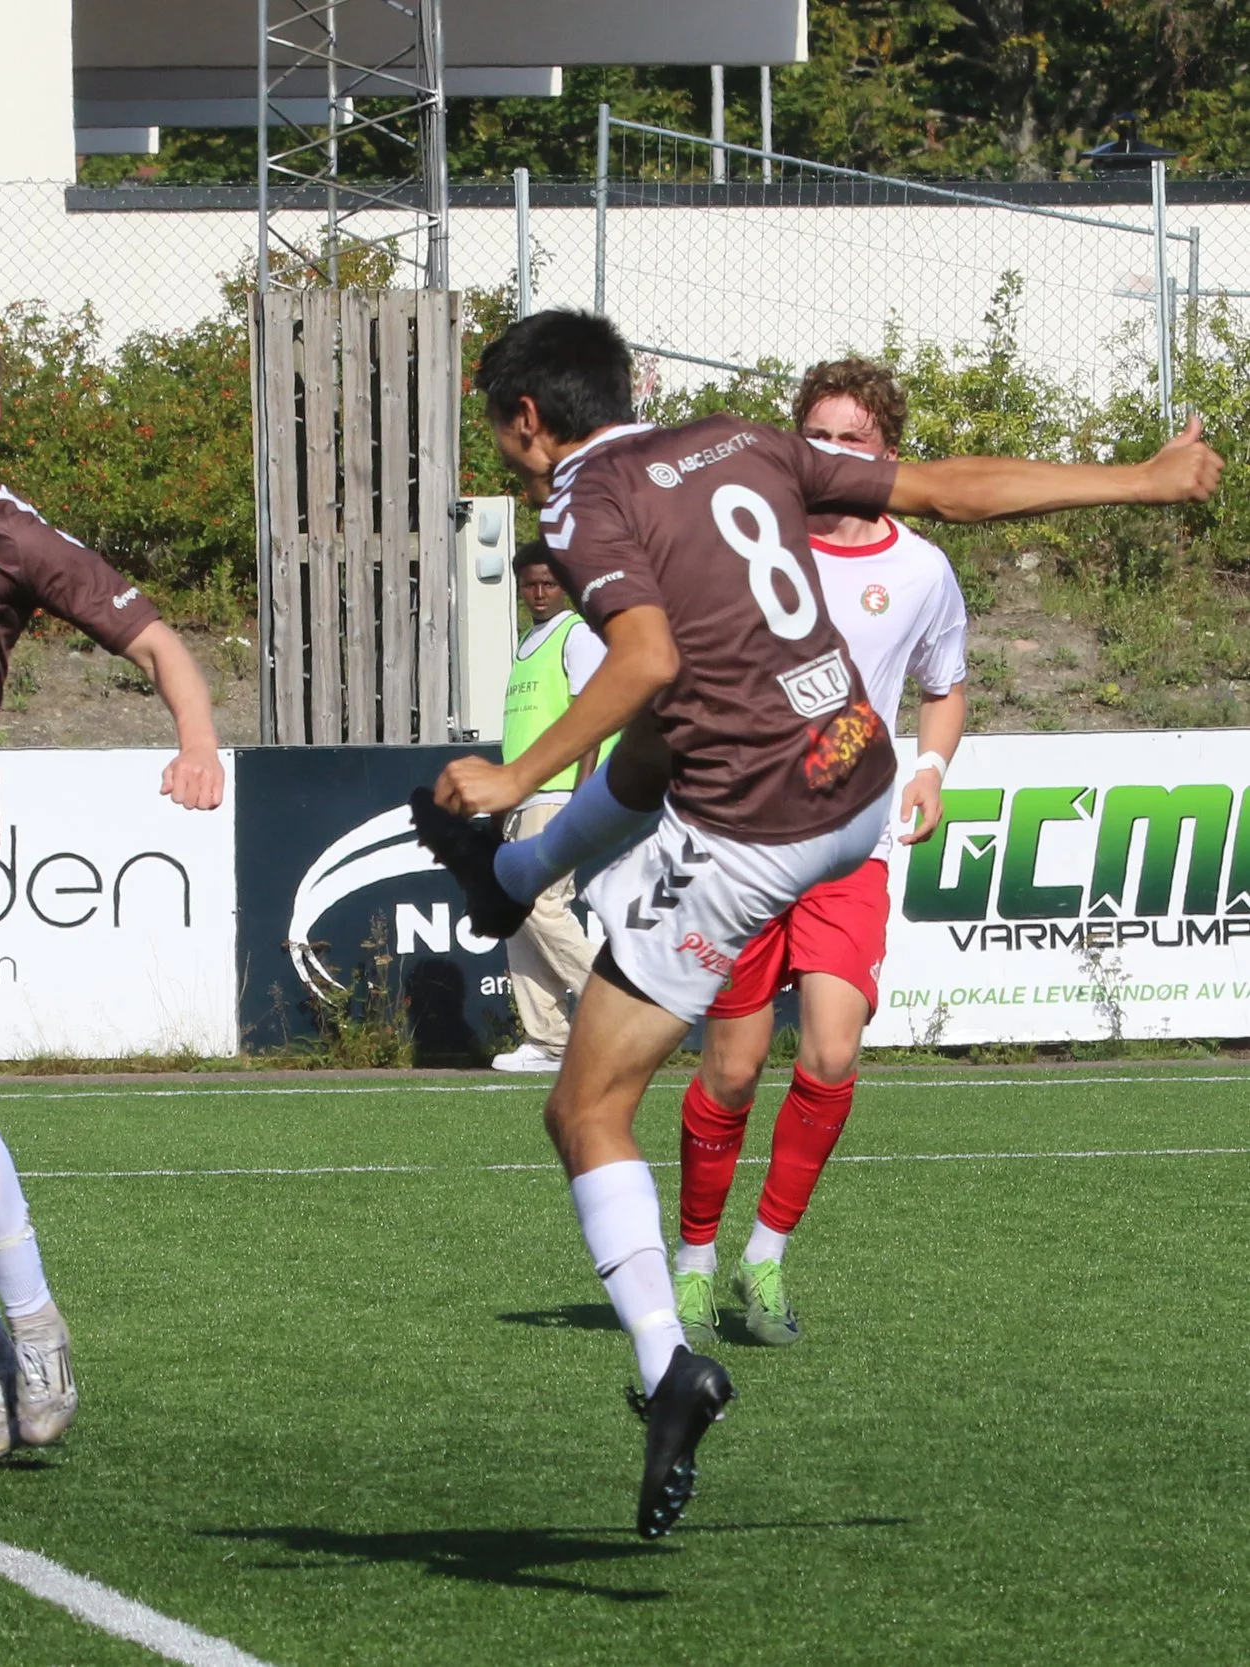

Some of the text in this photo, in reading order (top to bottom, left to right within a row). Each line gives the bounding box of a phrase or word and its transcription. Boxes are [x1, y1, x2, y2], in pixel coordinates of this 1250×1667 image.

[711, 484, 818, 641] 8
[796, 668, 843, 709] SLP
[902, 783, 1250, 923] GCM
[890, 989, 930, 1008] DIN
[937, 986, 1026, 1006] LOKALE
[1033, 983, 1190, 1004] LEVERANDØR
[1196, 982, 1227, 999] AV
